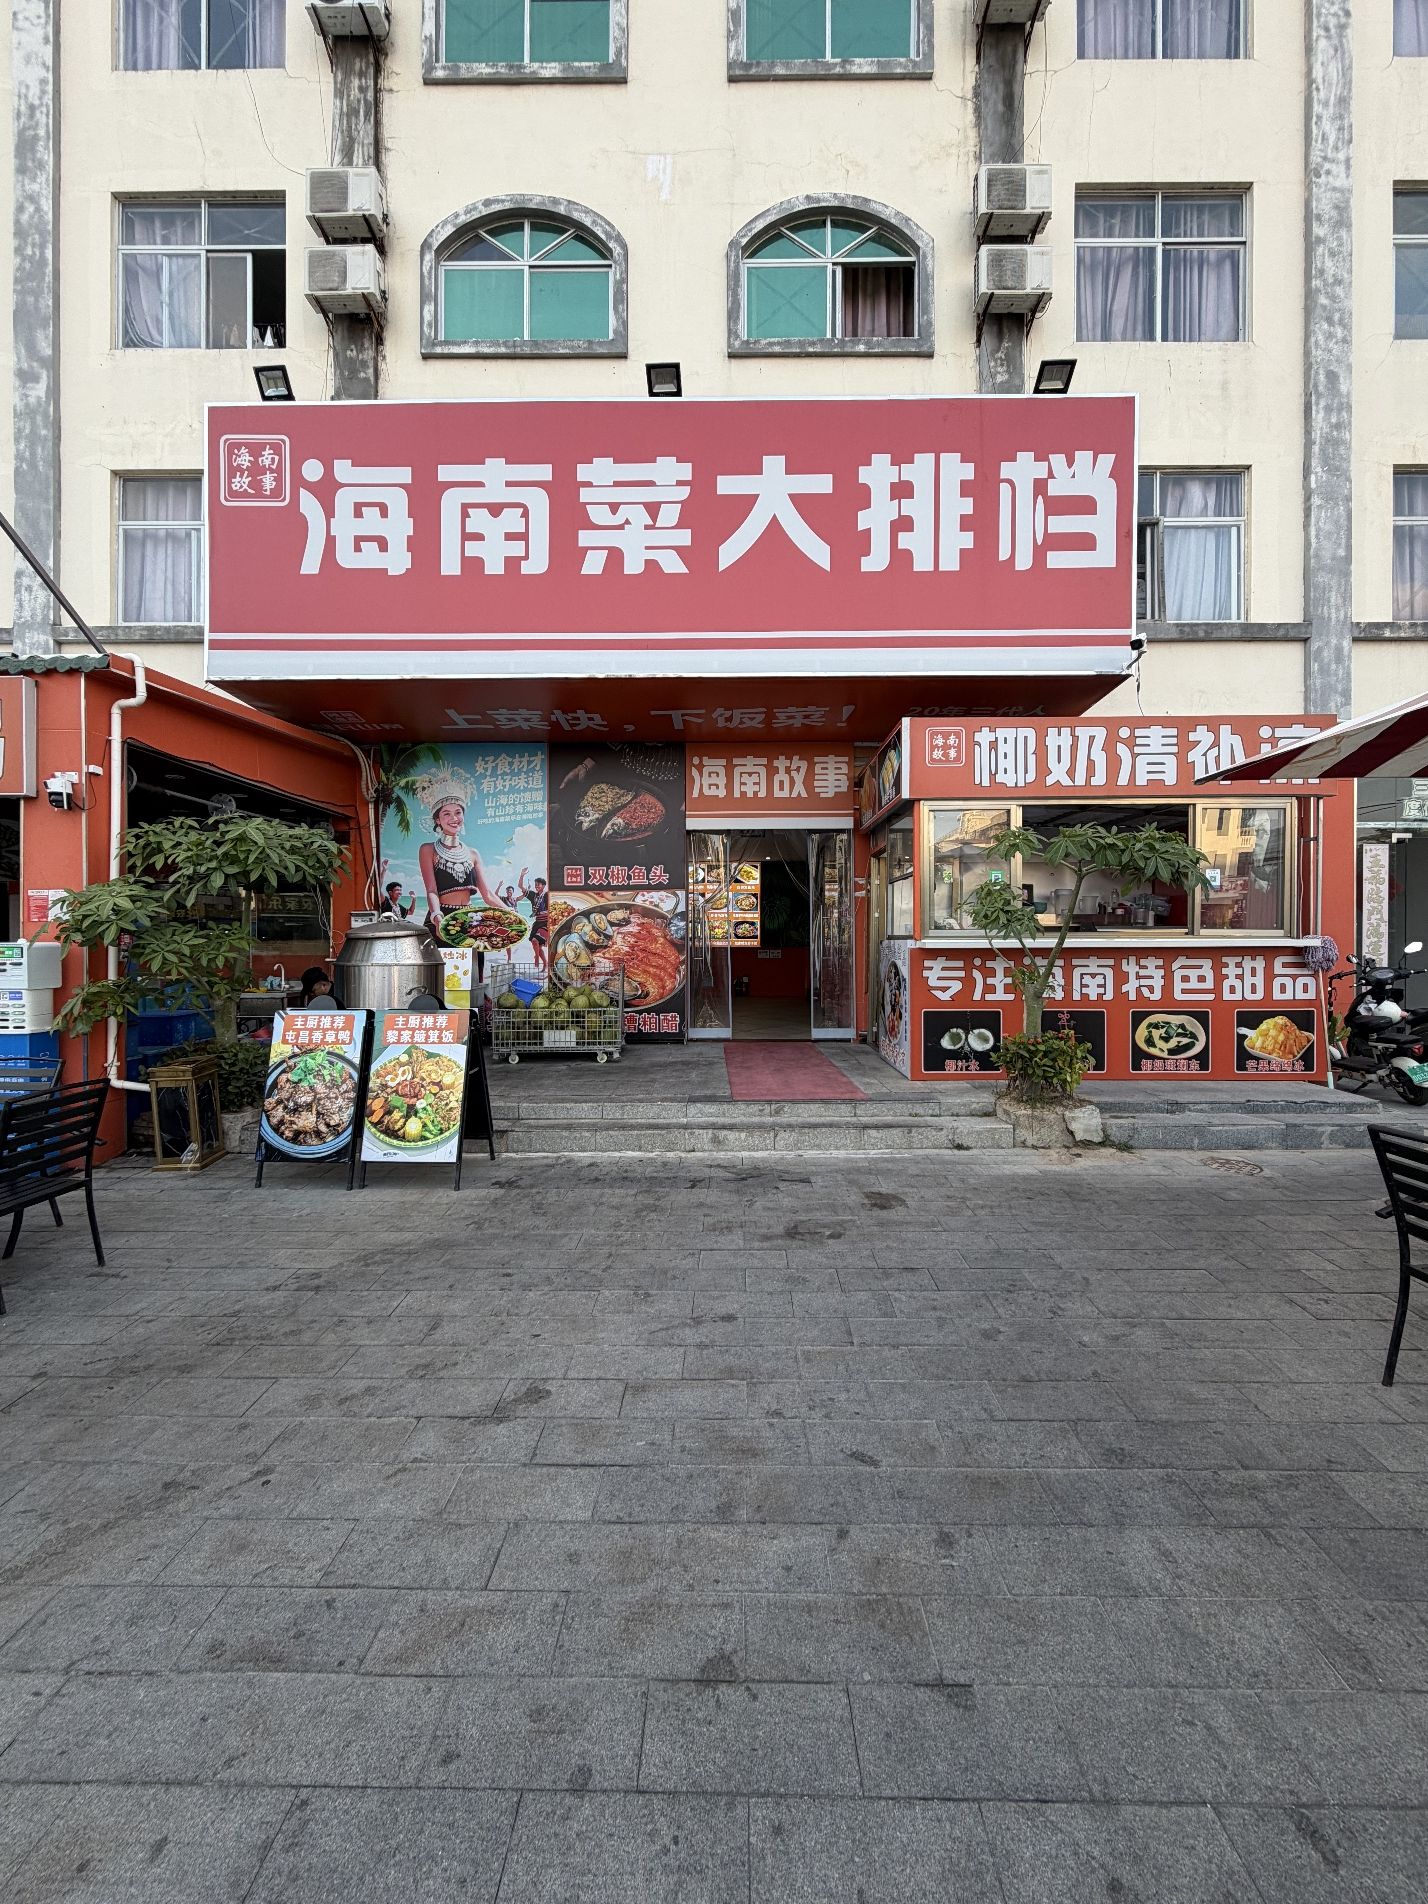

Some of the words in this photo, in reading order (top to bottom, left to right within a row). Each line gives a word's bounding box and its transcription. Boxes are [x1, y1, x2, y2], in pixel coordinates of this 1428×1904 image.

[232, 445, 279, 469] 海南
[231, 470, 278, 495] 故事
[299, 450, 1117, 576] 海南菜大排档
[932, 733, 959, 747] 海南
[475, 751, 544, 777] 好食材才
[932, 747, 958, 761] 故事
[480, 771, 544, 793] 有好味道
[691, 754, 849, 798] 海南故事
[588, 864, 669, 886] 双椒鱼头
[293, 1016, 346, 1029] 主厨推荐
[394, 1016, 448, 1029] 主厨推荐
[285, 1030, 351, 1044] 屯昌香草鸭
